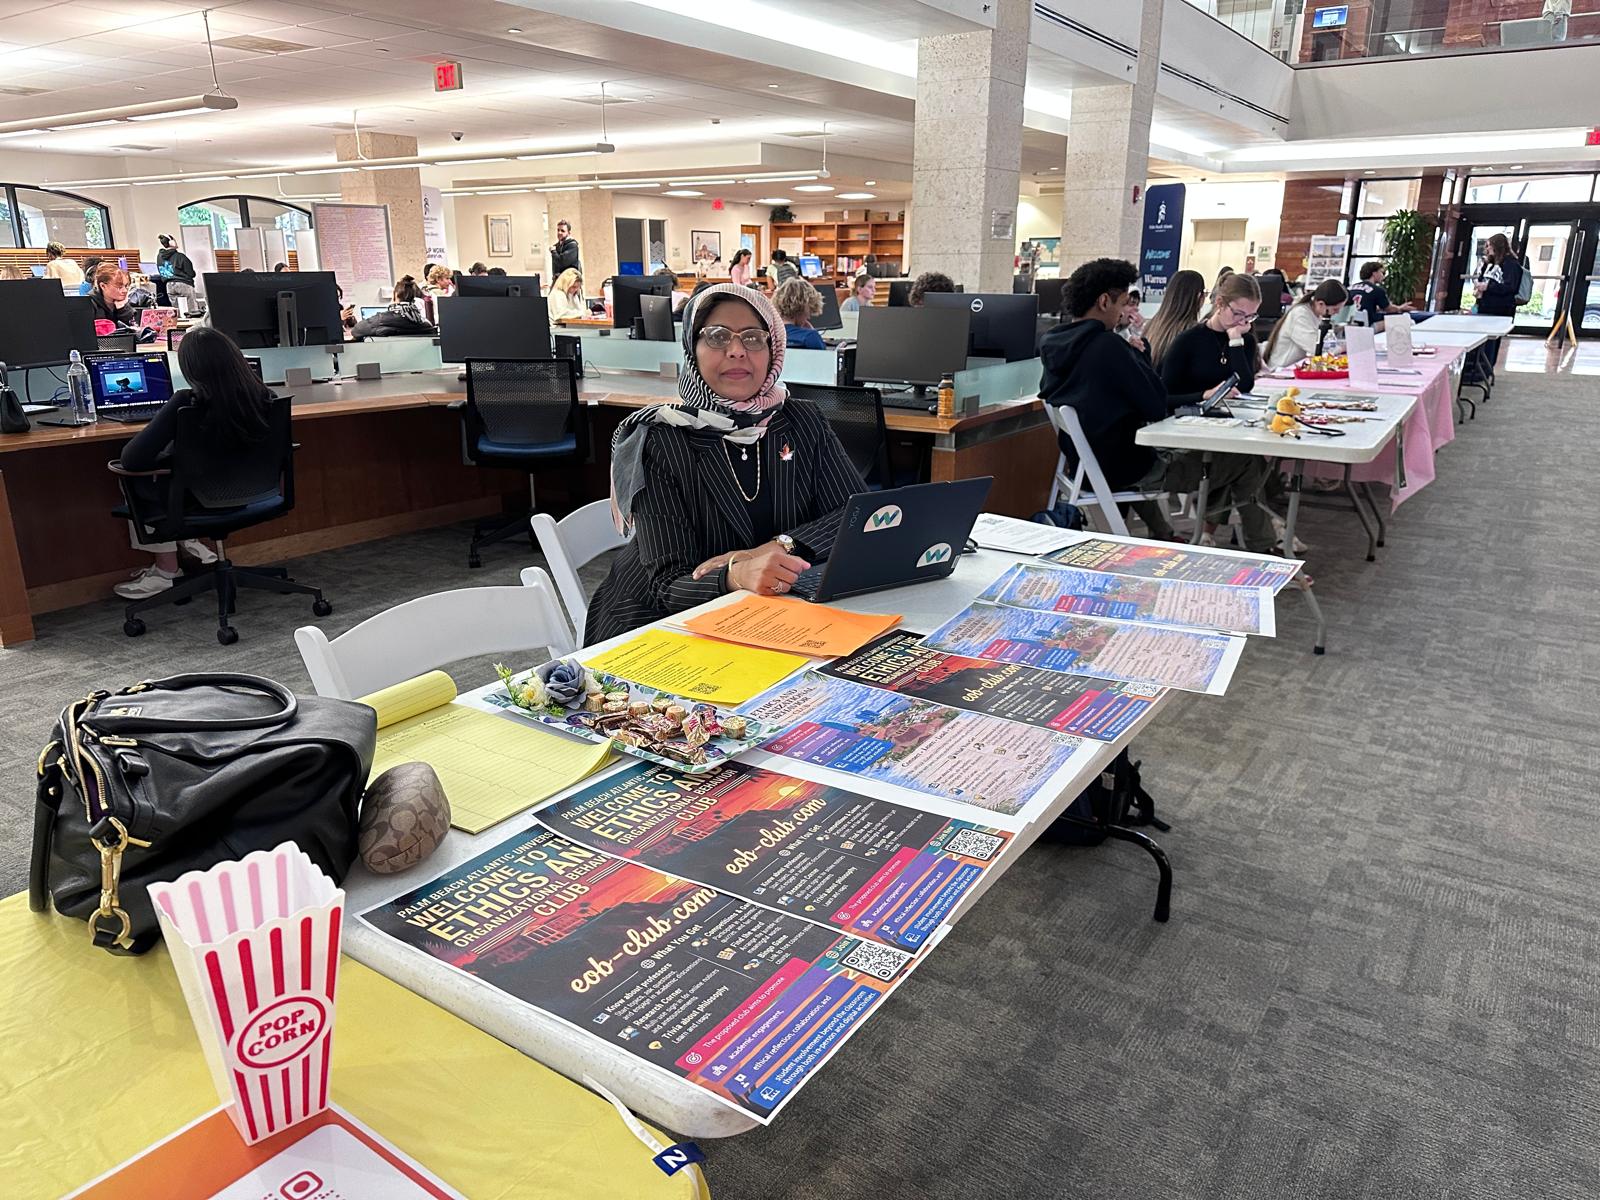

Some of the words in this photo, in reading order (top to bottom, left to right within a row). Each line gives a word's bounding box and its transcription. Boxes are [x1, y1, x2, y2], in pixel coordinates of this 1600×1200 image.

[1144, 274, 1167, 284] Warren
[842, 651, 894, 676] WELCOME
[897, 636, 921, 646] THE
[858, 654, 914, 681] ETHICS
[915, 659, 942, 673] CLUB
[748, 698, 781, 716] ETHICS
[778, 688, 799, 699] AND
[561, 805, 587, 819] PALM
[584, 792, 612, 807] BEACH
[609, 775, 645, 795] ATLANTIC
[570, 784, 655, 829] WELCOME
[645, 774, 673, 785] TO
[591, 790, 681, 840] ETHICS
[617, 796, 699, 844] ORGANIZATIONAL
[693, 770, 738, 795] BEHAVIOR
[675, 797, 717, 820] CLUB
[726, 798, 827, 874] eob-club.com
[785, 839, 804, 850] What
[798, 832, 813, 840] You
[808, 824, 822, 832] Get
[396, 898, 432, 918] PALM
[429, 879, 468, 900] BEACH
[466, 853, 515, 881] ATLANTIC
[406, 865, 522, 927] WELCOME
[513, 850, 548, 866] TO
[534, 883, 590, 916] CLUB
[427, 872, 549, 941] ETHICS
[454, 881, 570, 947] ORGANIZATIONAL
[704, 913, 739, 937] Competitions
[571, 888, 717, 993] eob-club.com
[651, 944, 676, 960] What
[670, 934, 690, 945] You
[685, 924, 703, 935] Get
[730, 937, 745, 948] Find
[741, 931, 753, 939] the
[751, 921, 765, 932] word
[757, 946, 775, 958] Bingo
[771, 935, 789, 946] Game
[835, 940, 851, 952] Join
[605, 999, 625, 1013] Know
[623, 985, 643, 1000] about
[640, 963, 672, 988] professors
[632, 1003, 664, 1026] Research
[660, 988, 683, 1004] Corner
[258, 1009, 304, 1039] POP
[661, 1024, 683, 1039] Trivia
[680, 1010, 700, 1025] about
[696, 985, 729, 1012] philosophy
[703, 1038, 717, 1048] The
[714, 1018, 740, 1040] proposed
[735, 1008, 751, 1019] club
[748, 999, 761, 1010] aims
[764, 977, 785, 995] promote
[248, 1018, 316, 1057] CORN
[728, 1037, 754, 1059] academic
[753, 1053, 772, 1070] ethical
[821, 995, 832, 1005] and
[775, 1062, 796, 1081] student
[792, 1034, 823, 1063] involvement
[819, 1017, 839, 1035] beyond
[844, 991, 866, 1011] classroom
[782, 1065, 806, 1085] through
[800, 1054, 817, 1066] both
[813, 1032, 837, 1055] in-person
[834, 1022, 846, 1033] and
[842, 1009, 858, 1024] digital
